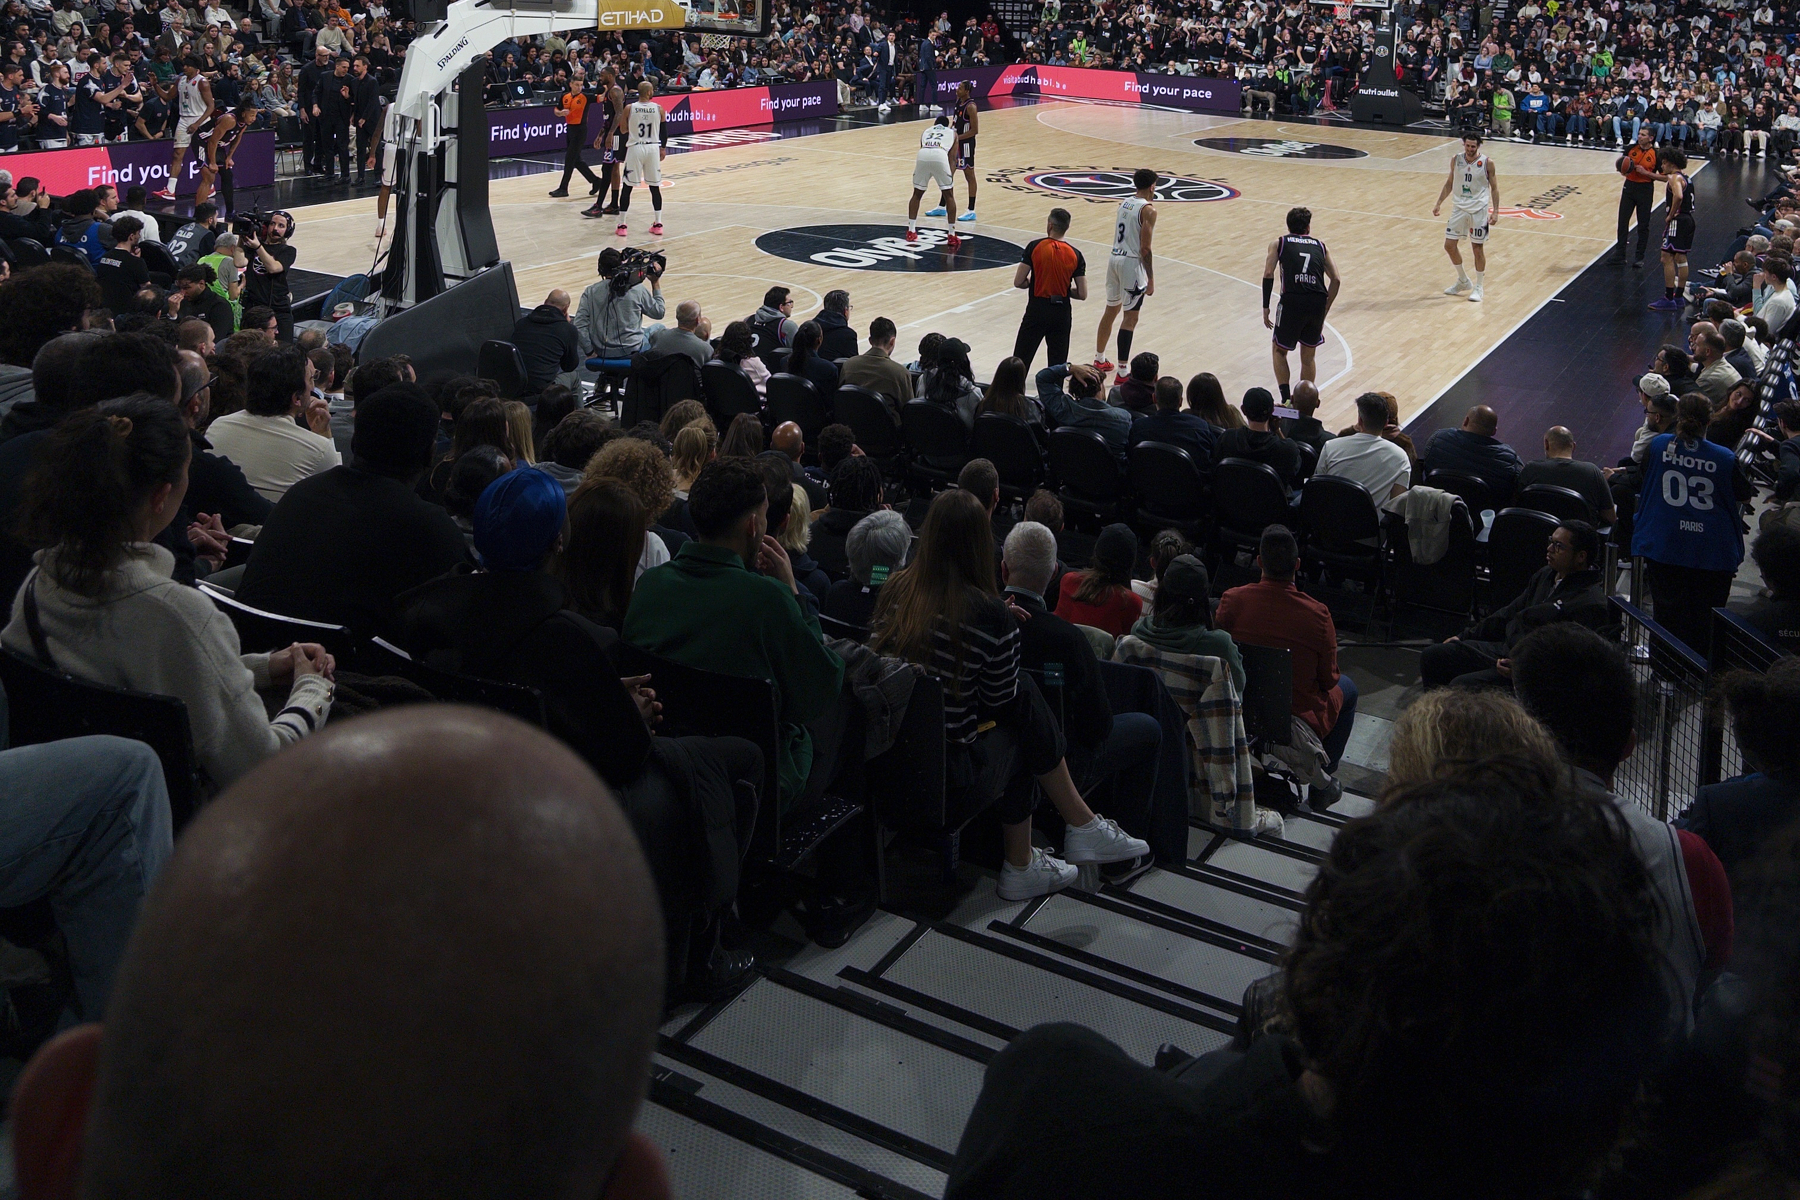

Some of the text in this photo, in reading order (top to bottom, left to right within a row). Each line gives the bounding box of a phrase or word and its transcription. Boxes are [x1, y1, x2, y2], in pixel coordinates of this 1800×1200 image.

[600, 9, 664, 26] ETIHAD
[436, 36, 470, 71] SPALDING
[1124, 81, 1212, 101] Find your pace
[760, 96, 822, 113] Find your pace
[491, 124, 552, 142] Find your
[638, 123, 652, 138] 31
[926, 132, 944, 140] 32
[88, 163, 133, 186] Find
[138, 165, 176, 187] you
[1465, 173, 1472, 182] 10
[1117, 222, 1125, 243] 3
[1474, 228, 1482, 237] 10
[1299, 252, 1311, 274] 7
[1294, 274, 1317, 285] PARIS
[1662, 451, 1717, 473] PHOTO
[1662, 469, 1714, 511] 03
[1679, 520, 1704, 533] PARIS
